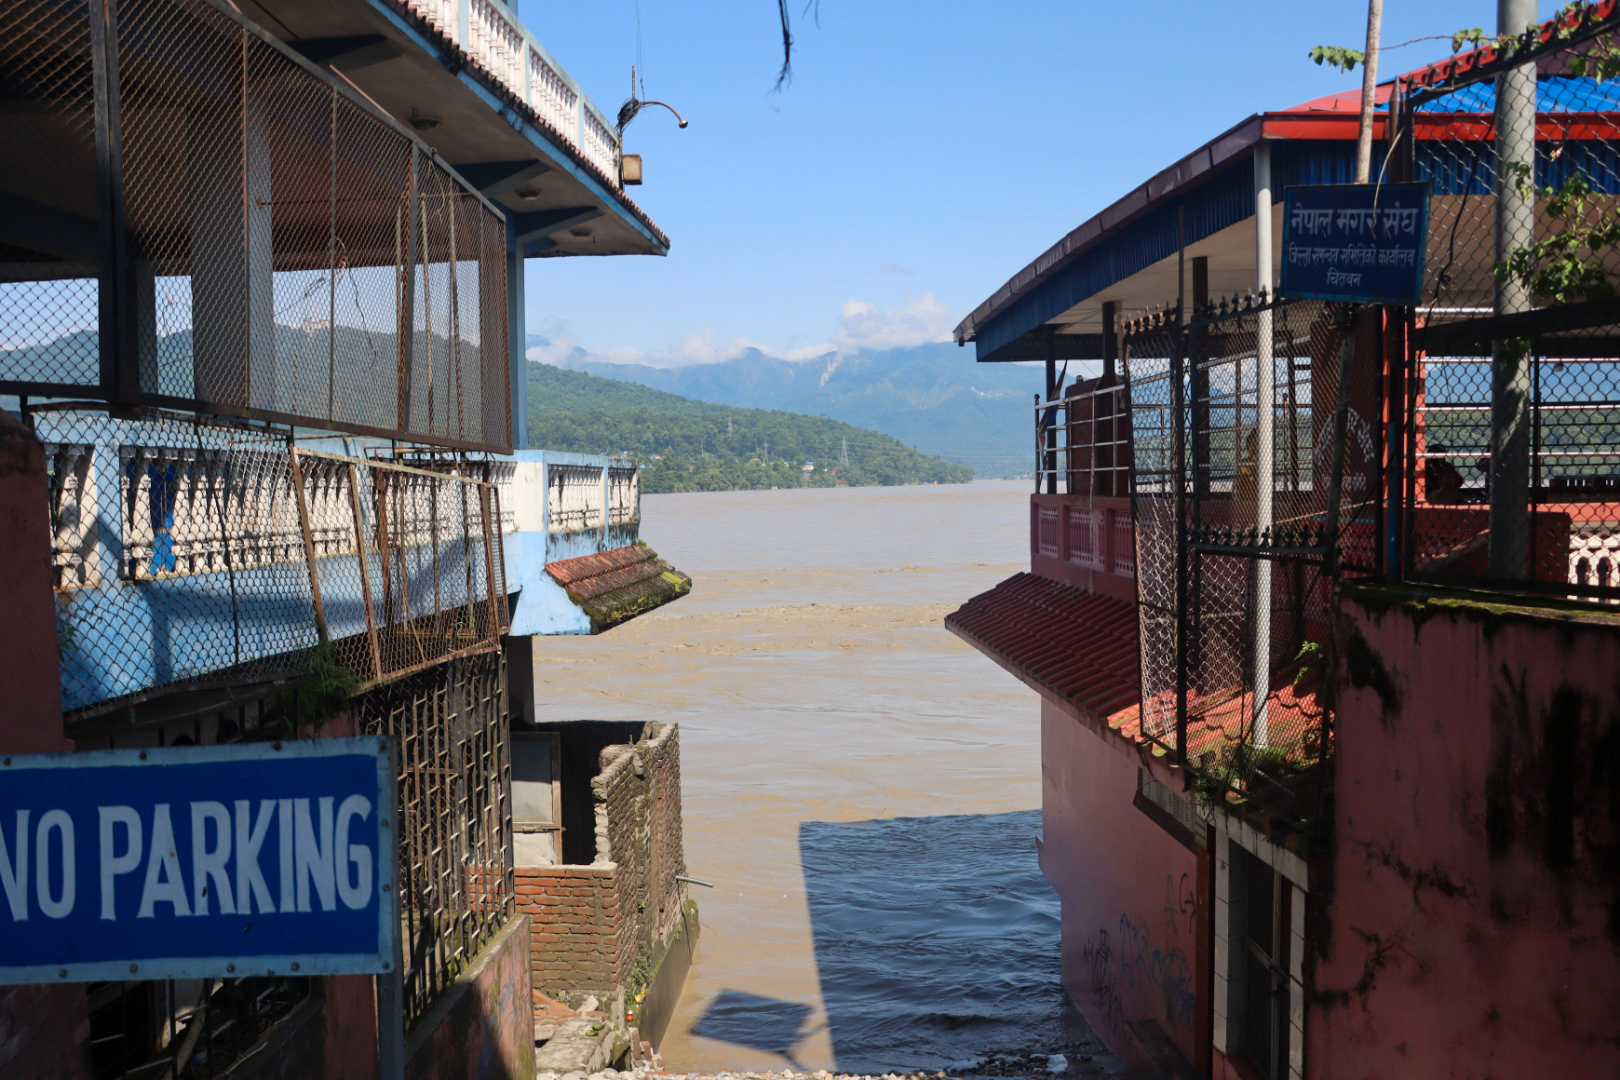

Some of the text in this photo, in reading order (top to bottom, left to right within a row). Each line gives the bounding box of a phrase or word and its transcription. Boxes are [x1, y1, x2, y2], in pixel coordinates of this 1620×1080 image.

[1291, 201, 1419, 240] नेपाल मगर संघ
[1326, 267, 1363, 288] चितवन
[97, 794, 373, 921] PARKING
